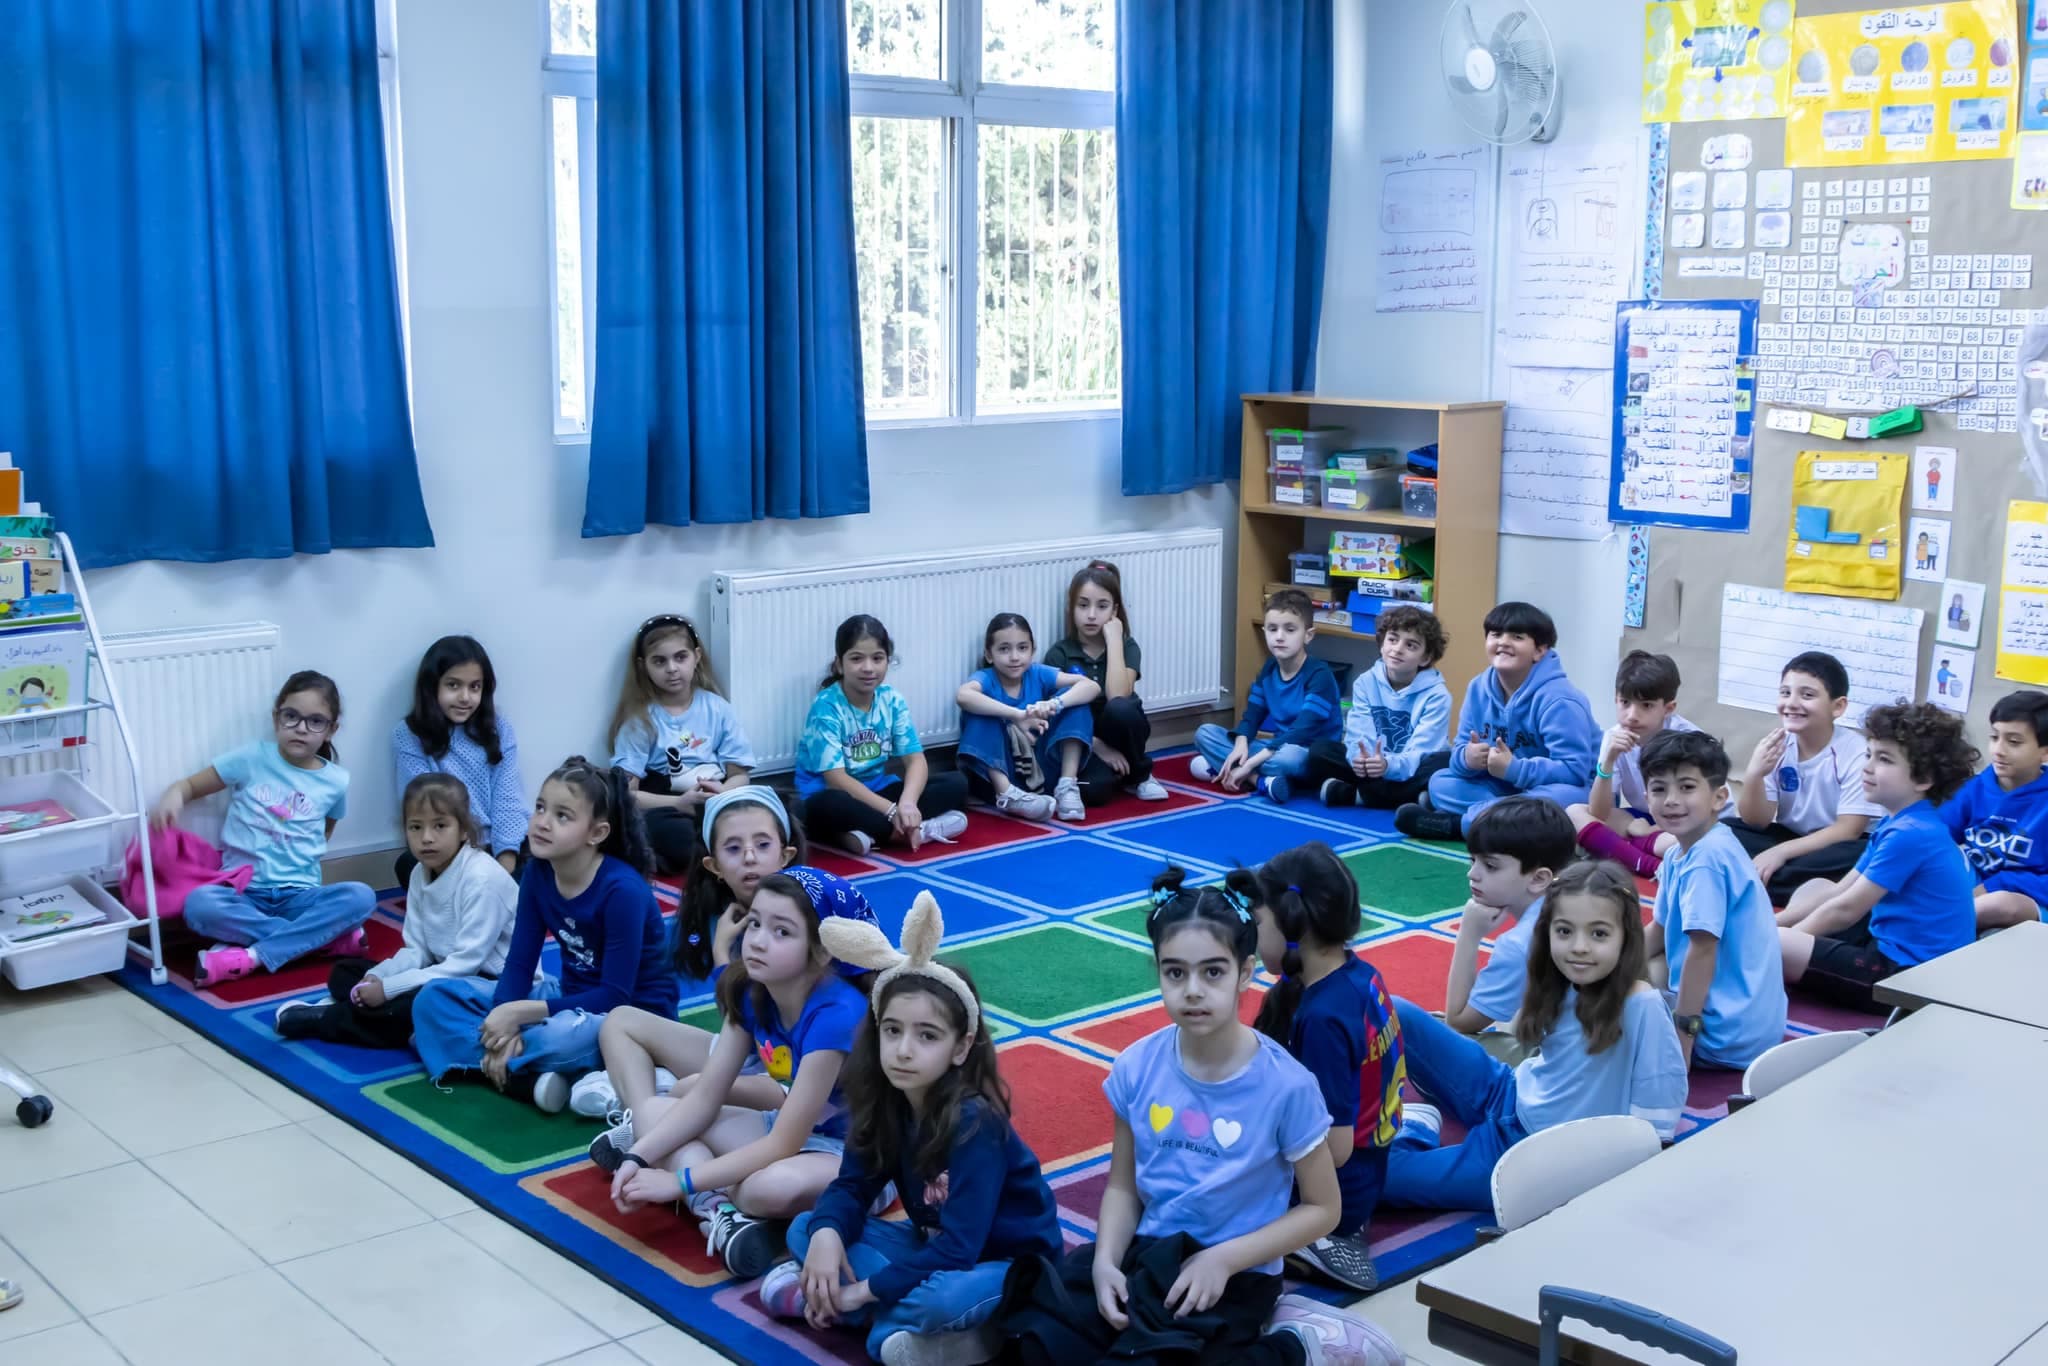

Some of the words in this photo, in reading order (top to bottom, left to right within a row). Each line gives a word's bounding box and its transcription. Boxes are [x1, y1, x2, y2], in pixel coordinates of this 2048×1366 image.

[1905, 11, 1937, 31] لوحة
[1919, 76, 1928, 85] 10
[1967, 73, 1973, 82] 5
[1914, 136, 1924, 145] 10
[1830, 204, 1840, 214] 11
[1805, 222, 1816, 232] 15
[1826, 223, 1837, 232] 14
[1824, 242, 1836, 251] 17
[1784, 260, 1796, 269] 27
[1914, 260, 1926, 270] 24
[1936, 259, 1949, 269] 23
[1956, 259, 1969, 269] 22
[1976, 259, 1988, 269] 21
[1997, 258, 2009, 268] 20
[2017, 259, 2028, 269] 19
[1804, 277, 1816, 286] 37
[1996, 276, 2008, 286] 31
[1784, 294, 1795, 304] 50
[1802, 294, 1814, 303] 49
[1838, 294, 1850, 303] 47
[1904, 294, 1916, 304] 45
[1923, 294, 1935, 304] 44
[1943, 294, 1955, 304] 43
[1963, 294, 1976, 304] 42
[1984, 294, 1996, 304] 41
[1802, 311, 1814, 319] 64
[1820, 311, 1832, 320] 63
[1840, 311, 1851, 320] 62
[1860, 312, 1871, 320] 61
[1879, 312, 1891, 320] 60
[1936, 312, 1948, 320] 57
[1956, 312, 1968, 321] 56
[1975, 313, 1987, 321] 55
[1996, 313, 2007, 322] 54
[1796, 328, 1808, 337] 77
[1815, 327, 1826, 337] 76
[1852, 328, 1864, 337] 74
[1872, 328, 1883, 337] 73
[1890, 330, 1901, 340] 72
[1908, 329, 1920, 339] 71
[1946, 330, 1959, 340] 69
[1967, 332, 1979, 342] 68
[1987, 332, 1999, 342] 67
[1761, 343, 1771, 352] 93
[1777, 343, 1788, 352] 92
[1813, 344, 1824, 353] 90
[1903, 348, 1915, 357] 85
[1921, 348, 1934, 357] 84
[1942, 350, 1953, 359] 83
[1961, 350, 1974, 359] 82
[1982, 351, 1994, 360] 81
[1751, 359, 1768, 368] 107
[1941, 367, 1953, 377] 97
[1962, 368, 1974, 377] 96
[1981, 367, 1993, 377] 95
[2001, 368, 2014, 377] 94
[1761, 375, 1776, 385] 121
[1940, 383, 1956, 393] 111
[1980, 385, 1998, 394] 109
[1855, 422, 1861, 431] 2
[1960, 418, 1976, 427] 135
[1361, 581, 1387, 589] QUICK
[1366, 587, 1390, 596] CUPS
[1158, 1139, 1173, 1149] LIFE
[1176, 1140, 1182, 1148] IS
[1185, 1141, 1218, 1158] BEAUTIFUL
